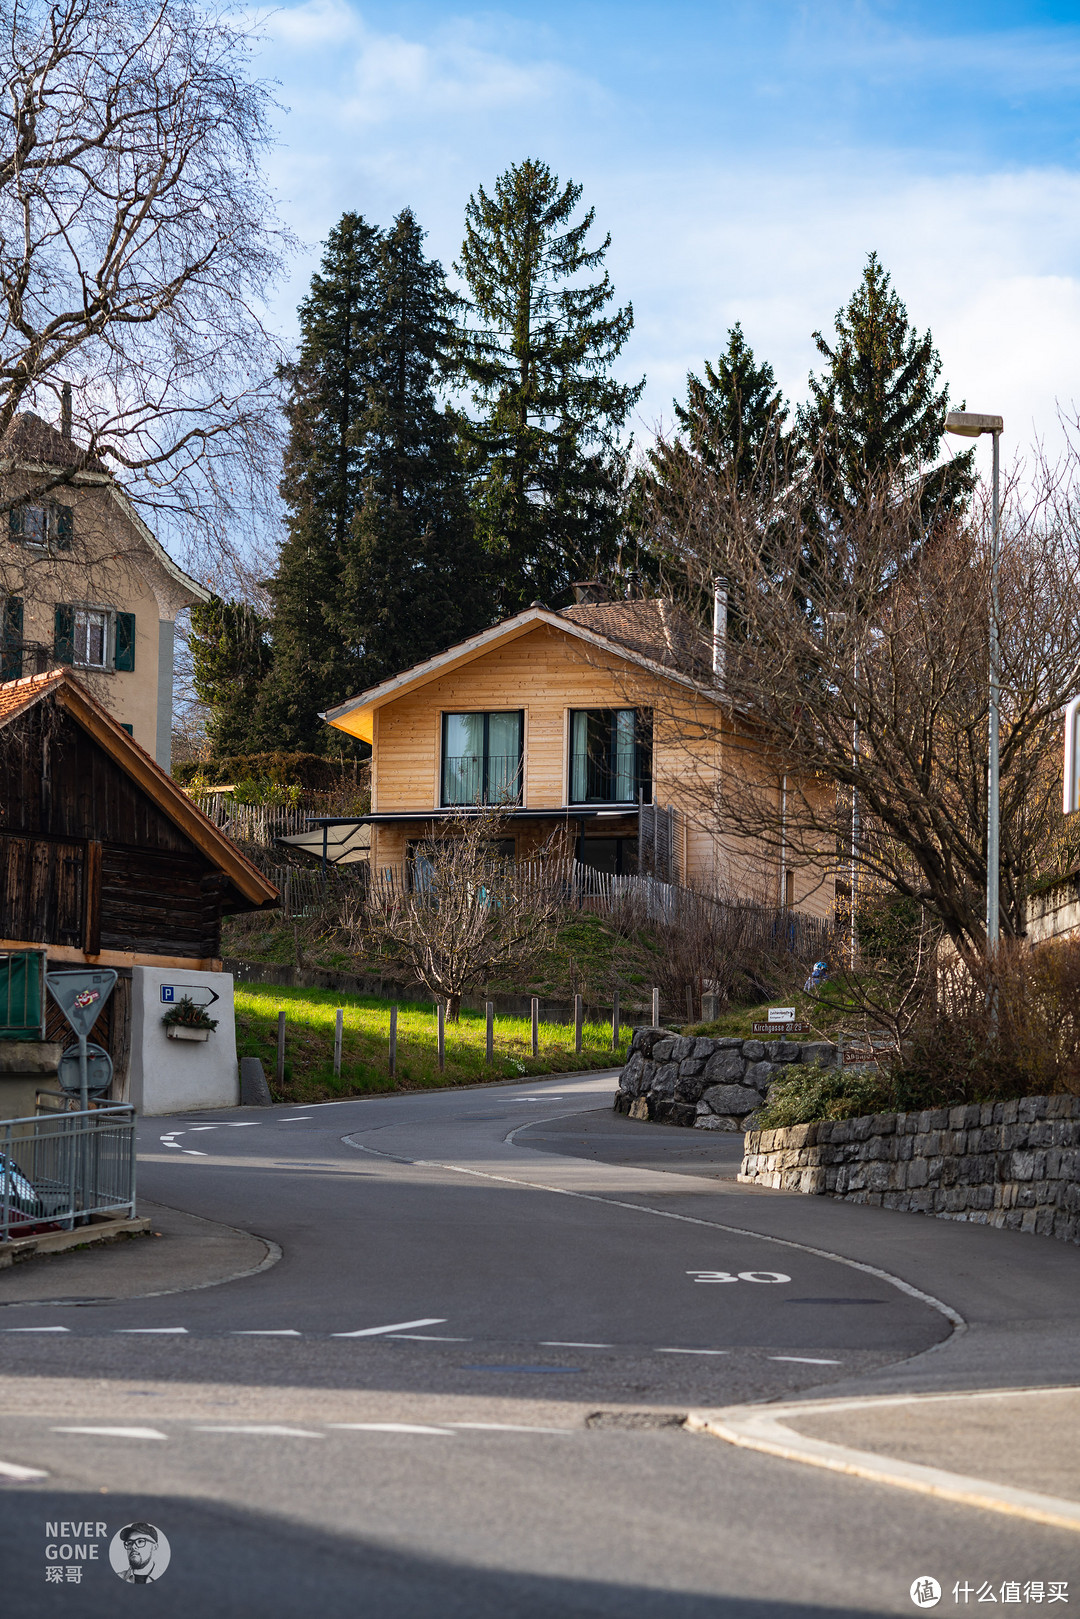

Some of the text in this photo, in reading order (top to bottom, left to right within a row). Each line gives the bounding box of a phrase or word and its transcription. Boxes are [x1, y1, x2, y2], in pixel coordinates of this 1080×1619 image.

[165, 988, 172, 1000] P
[754, 1023, 784, 1034] Kirchgasse
[685, 1270, 792, 1283] 30
